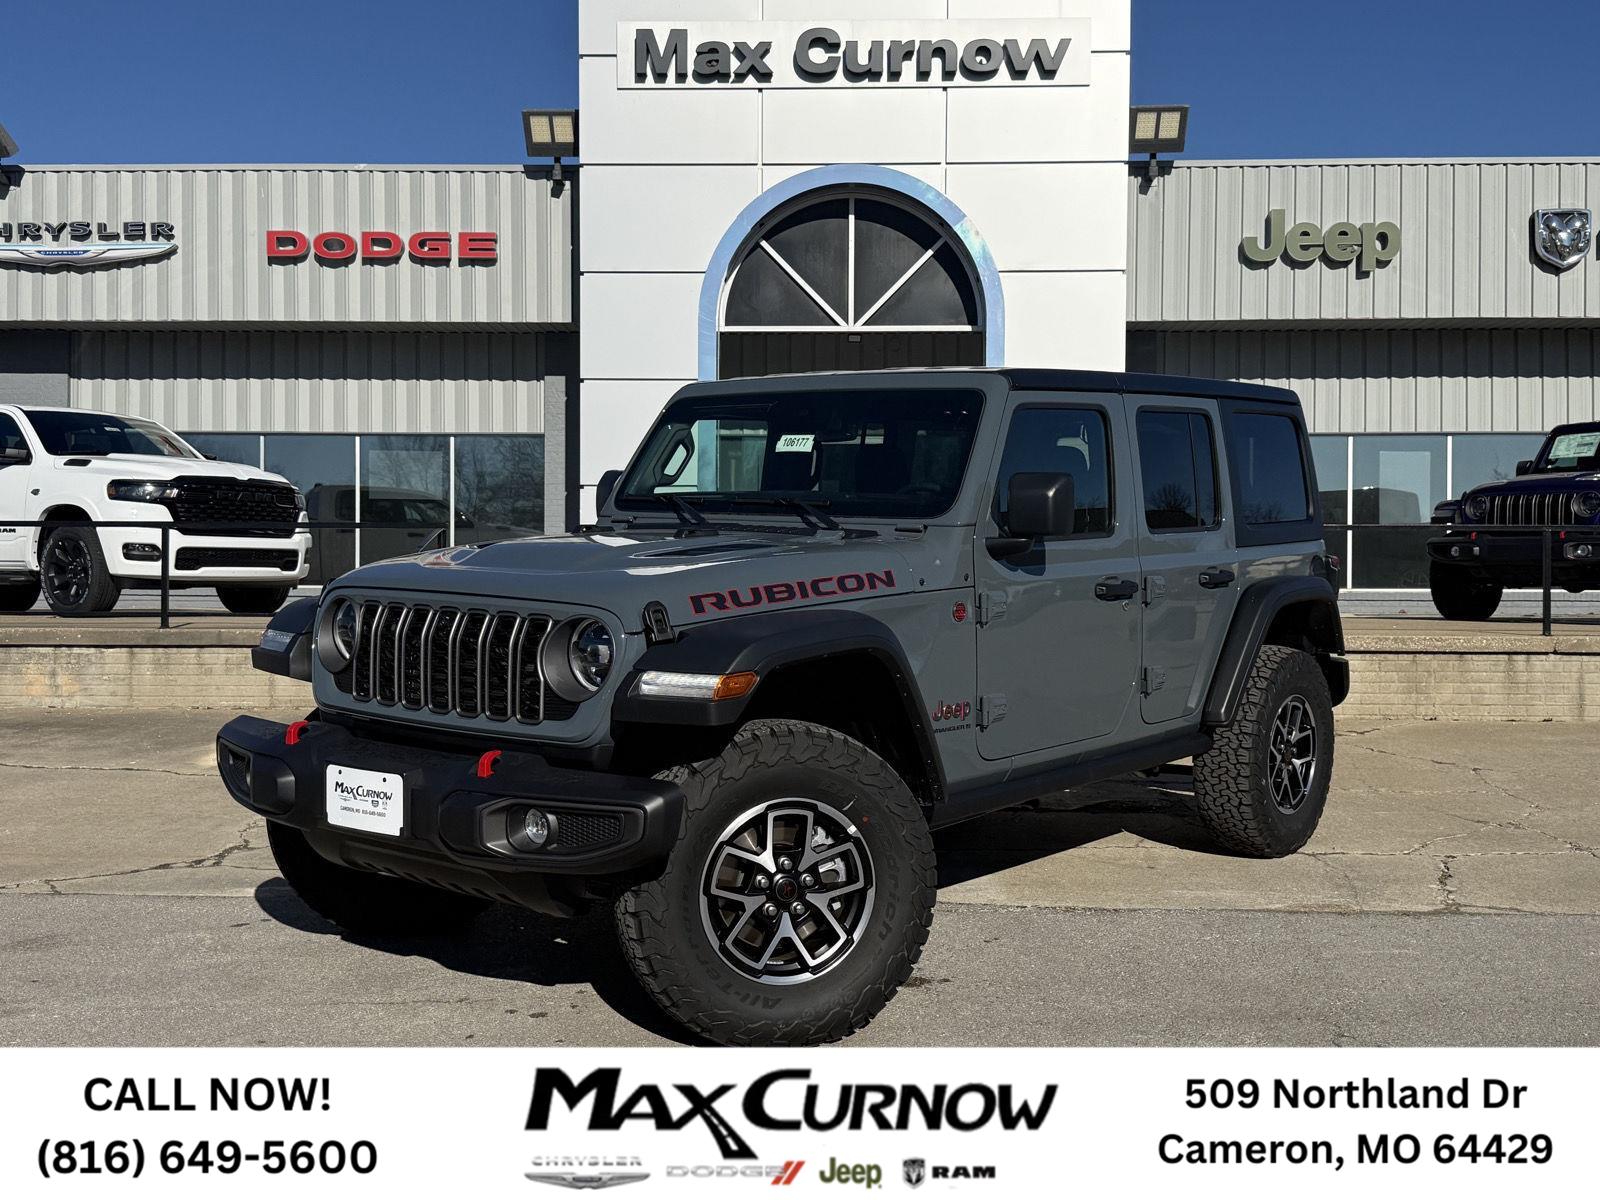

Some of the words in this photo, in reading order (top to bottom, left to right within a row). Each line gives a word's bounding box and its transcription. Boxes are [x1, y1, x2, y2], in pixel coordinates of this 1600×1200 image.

[634, 28, 772, 81] Max
[794, 27, 1072, 80] Curnow
[266, 230, 498, 264] DODGE
[1241, 208, 1402, 272] Jeep
[783, 437, 810, 448] 106177
[688, 568, 897, 615] RUBICON
[932, 700, 971, 722] Jeep
